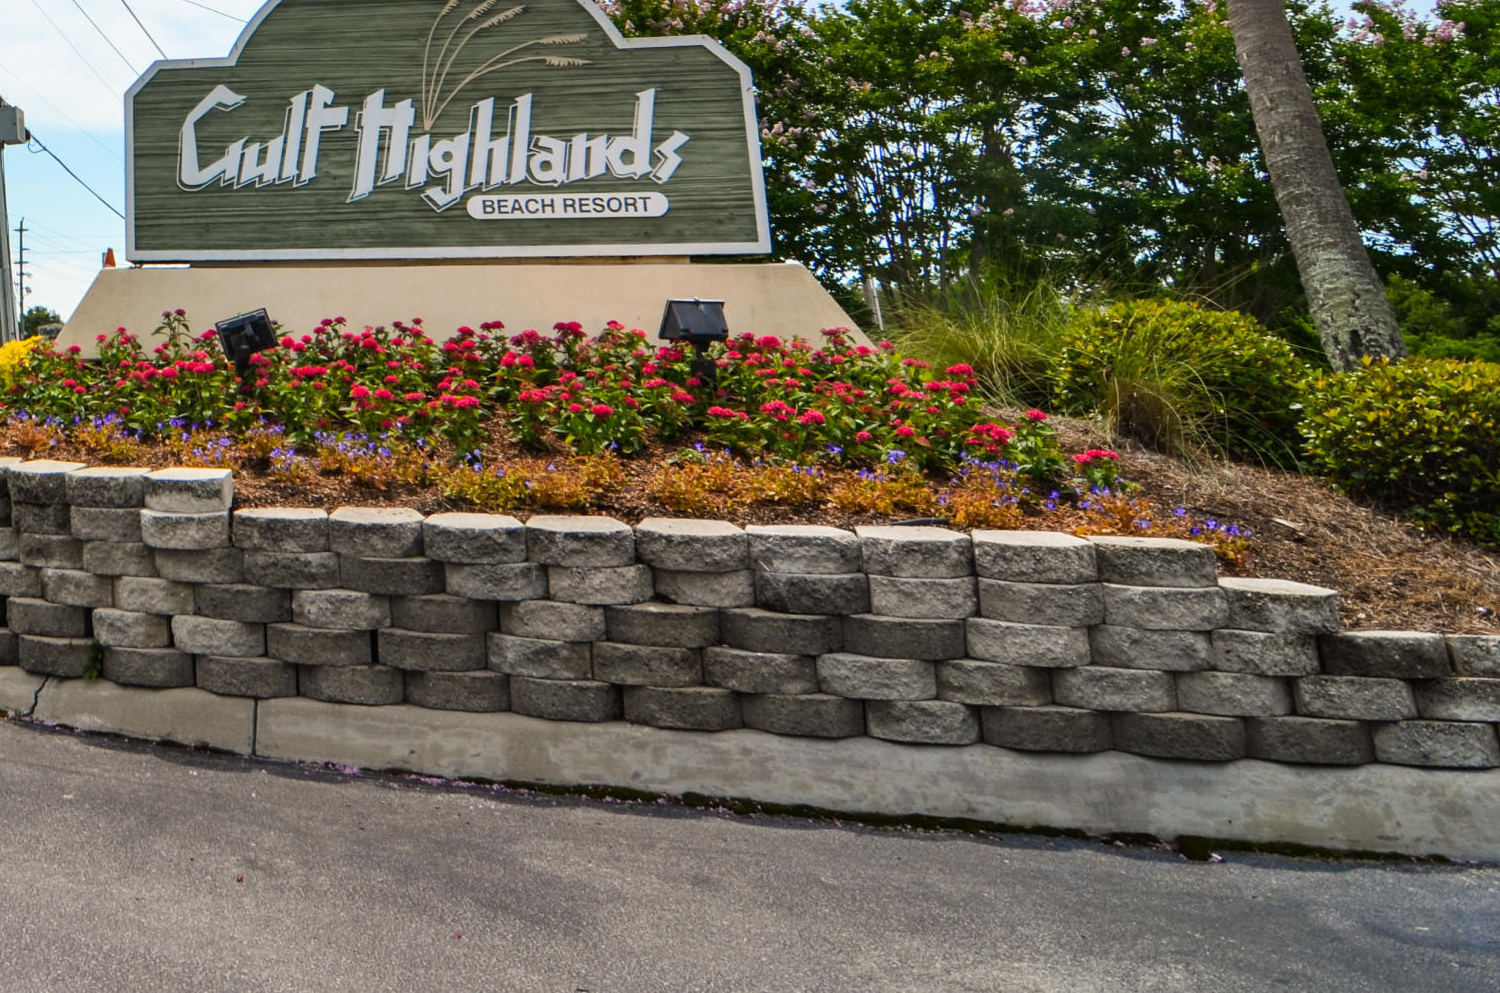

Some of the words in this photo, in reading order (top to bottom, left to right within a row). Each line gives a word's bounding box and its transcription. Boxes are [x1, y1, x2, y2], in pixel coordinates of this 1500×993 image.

[177, 83, 349, 192] Gulf
[346, 87, 691, 214] Highlands
[481, 197, 556, 215] BEACH
[562, 196, 652, 213] RESORT
